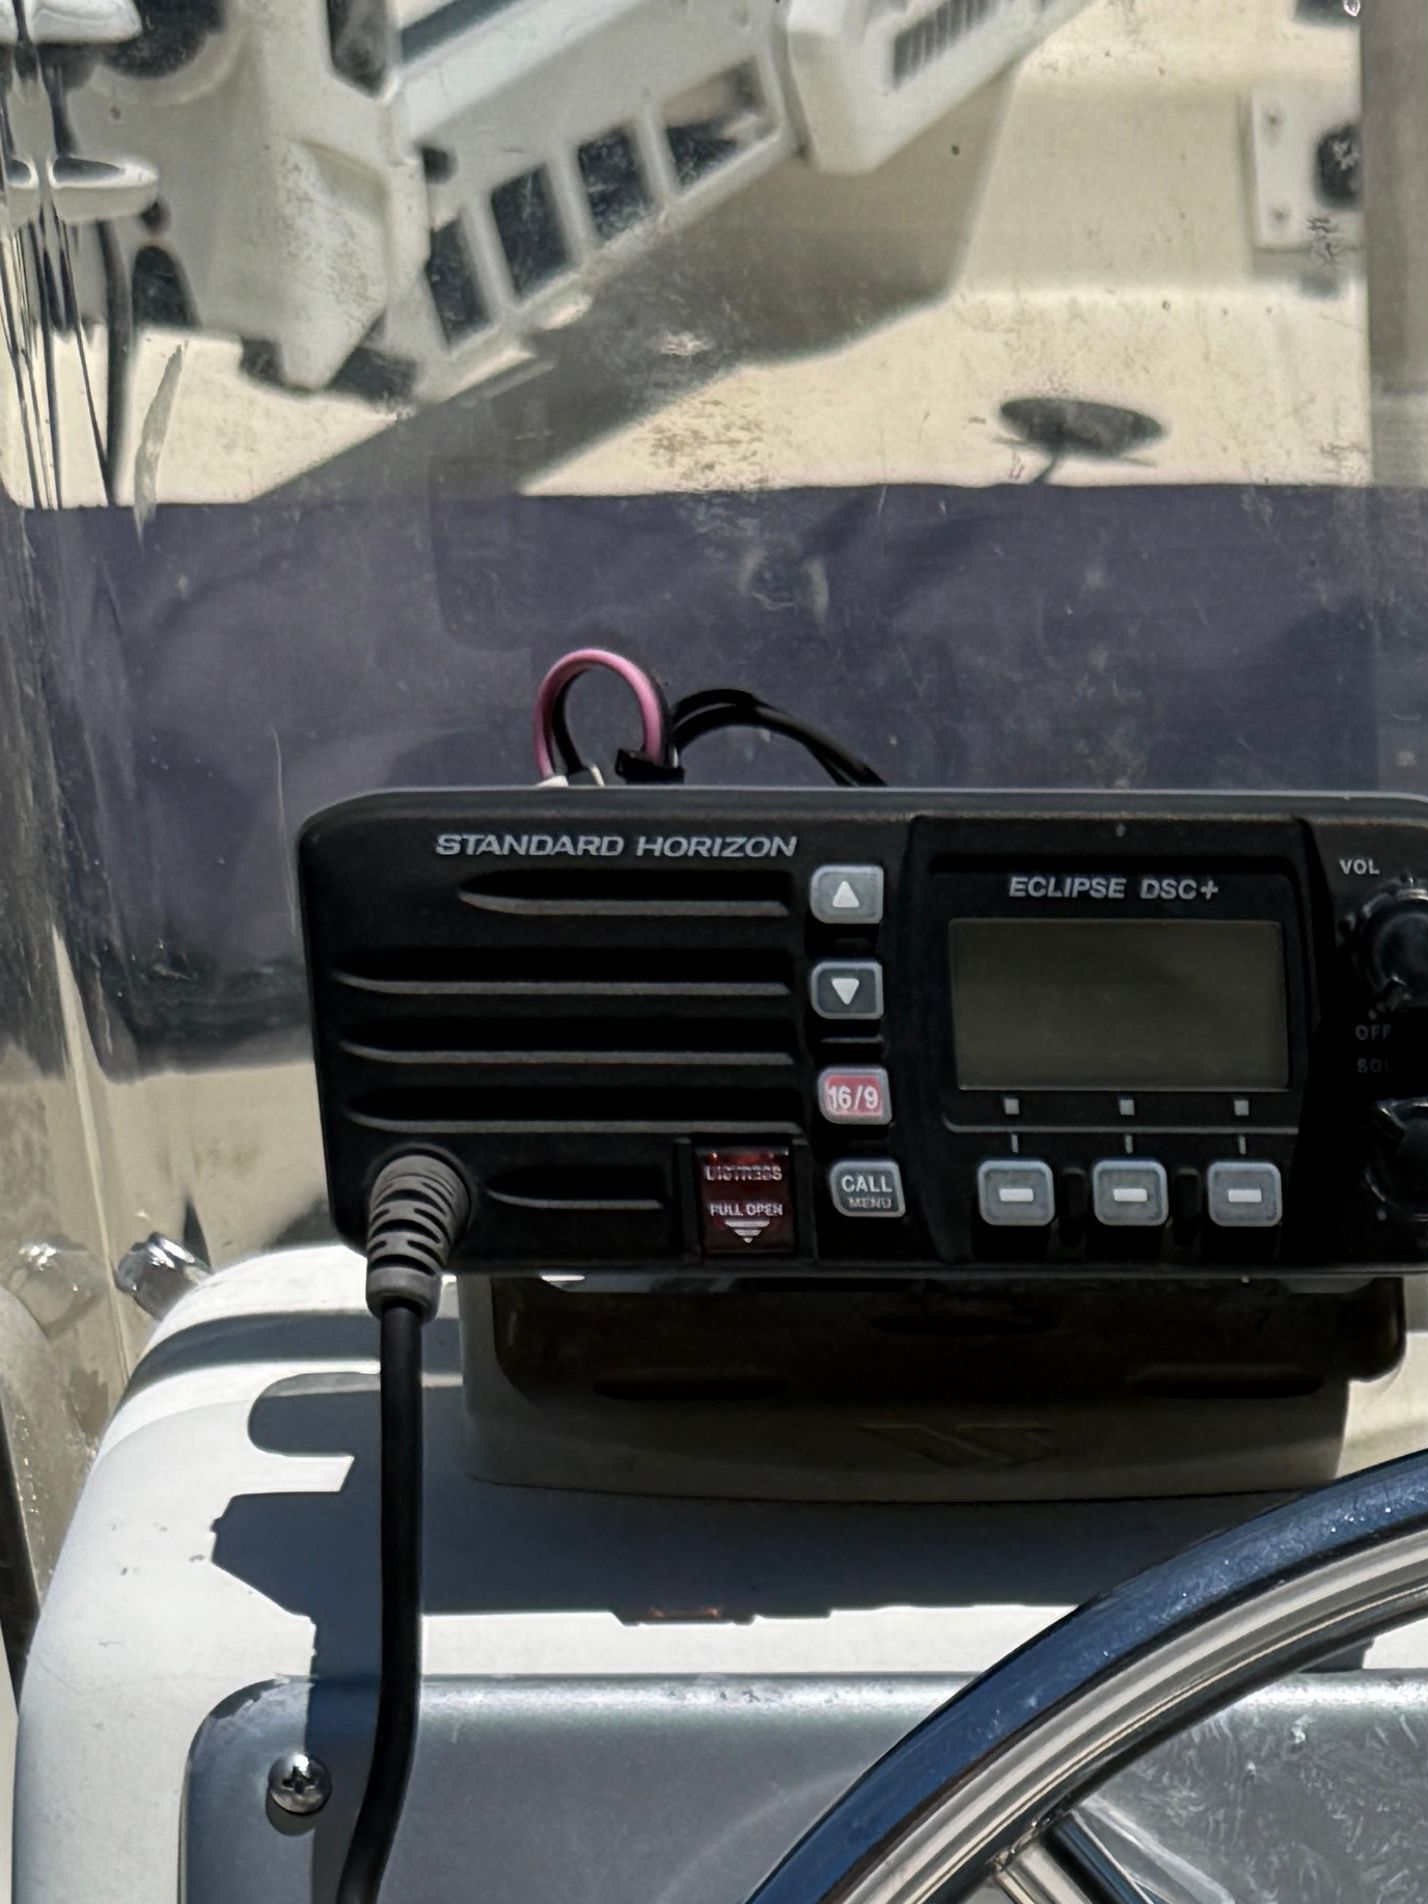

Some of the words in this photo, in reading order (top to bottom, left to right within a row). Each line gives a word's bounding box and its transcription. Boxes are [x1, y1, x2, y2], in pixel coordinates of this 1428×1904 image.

[436, 833, 625, 857] STANDARD
[636, 834, 799, 858] HORIZON
[1339, 858, 1380, 876] VOL
[1008, 876, 1127, 899] ECLIPSE
[1140, 878, 1218, 900] DSC+
[1355, 1023, 1392, 1041] OFF
[827, 1085, 879, 1111] 16/9
[841, 1174, 893, 1193] CALL
[710, 1202, 744, 1217] PULL
[746, 1202, 783, 1217] OPEN
[848, 1196, 892, 1210] MENU
